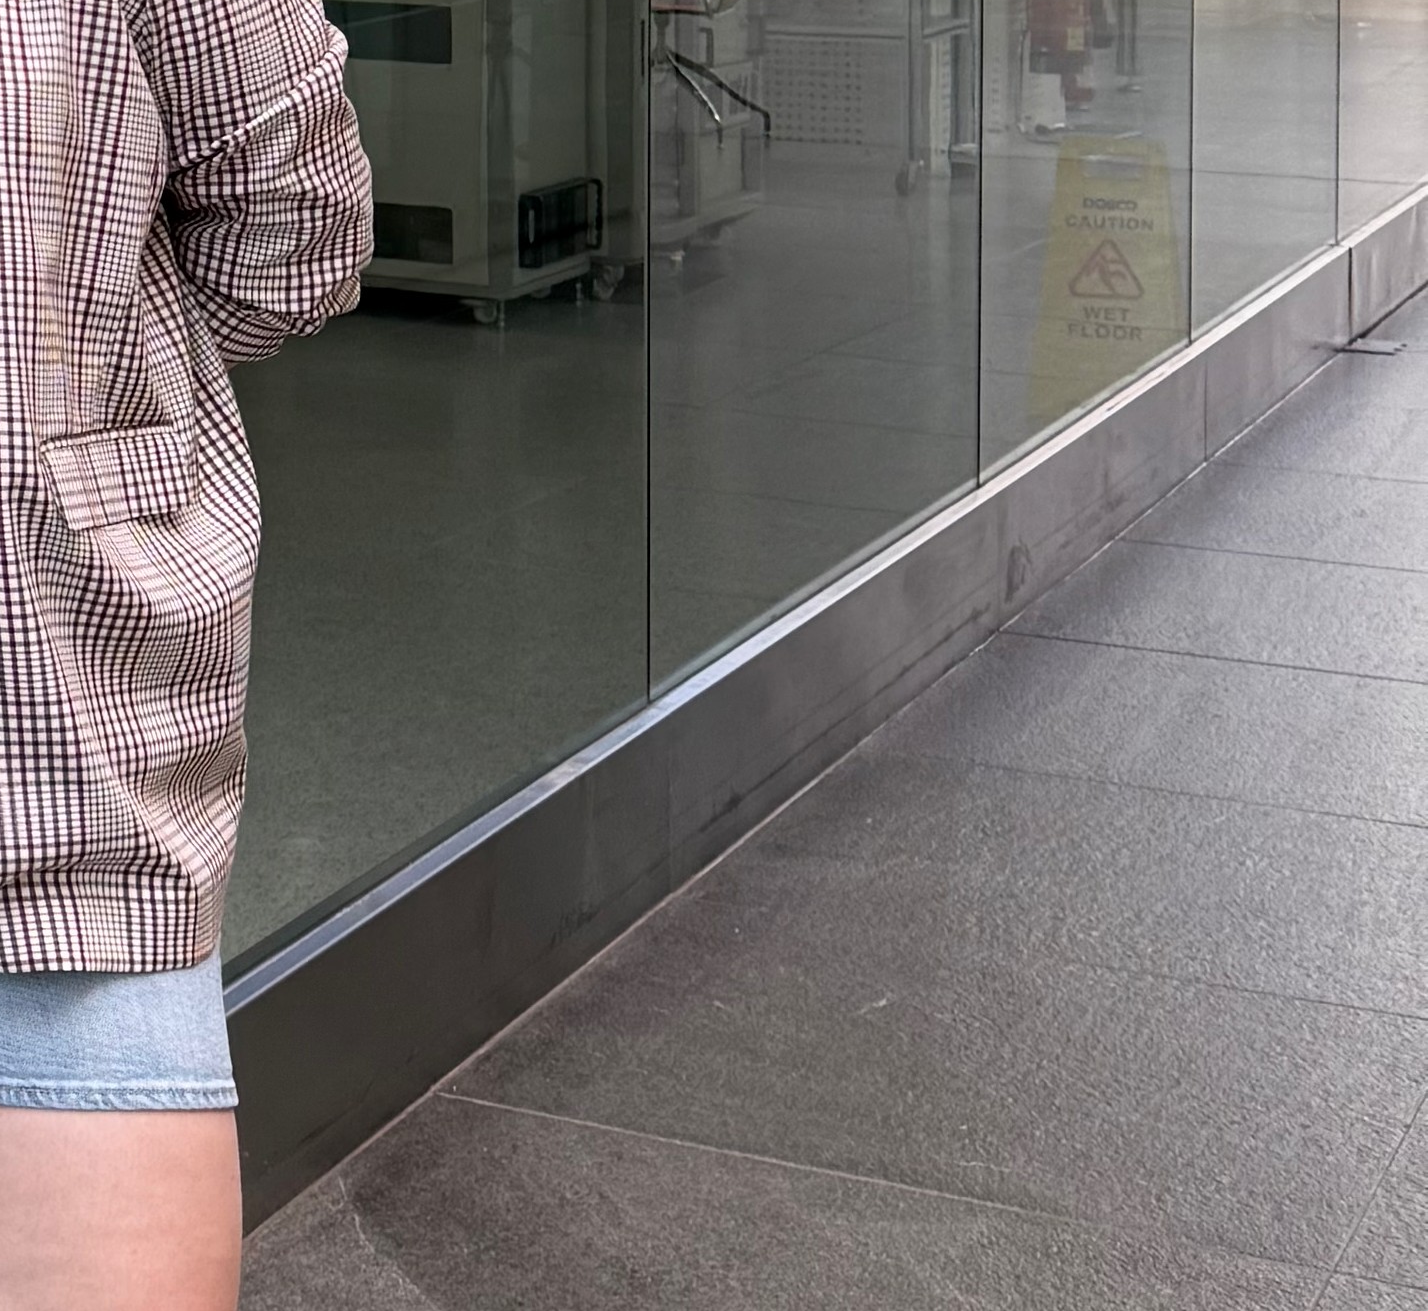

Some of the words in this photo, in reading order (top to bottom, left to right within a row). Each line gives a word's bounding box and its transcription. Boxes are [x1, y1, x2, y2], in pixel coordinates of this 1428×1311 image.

[1065, 214, 1154, 231] CAUTION
[1083, 306, 1130, 322] WET
[1067, 322, 1143, 340] FLOOR
